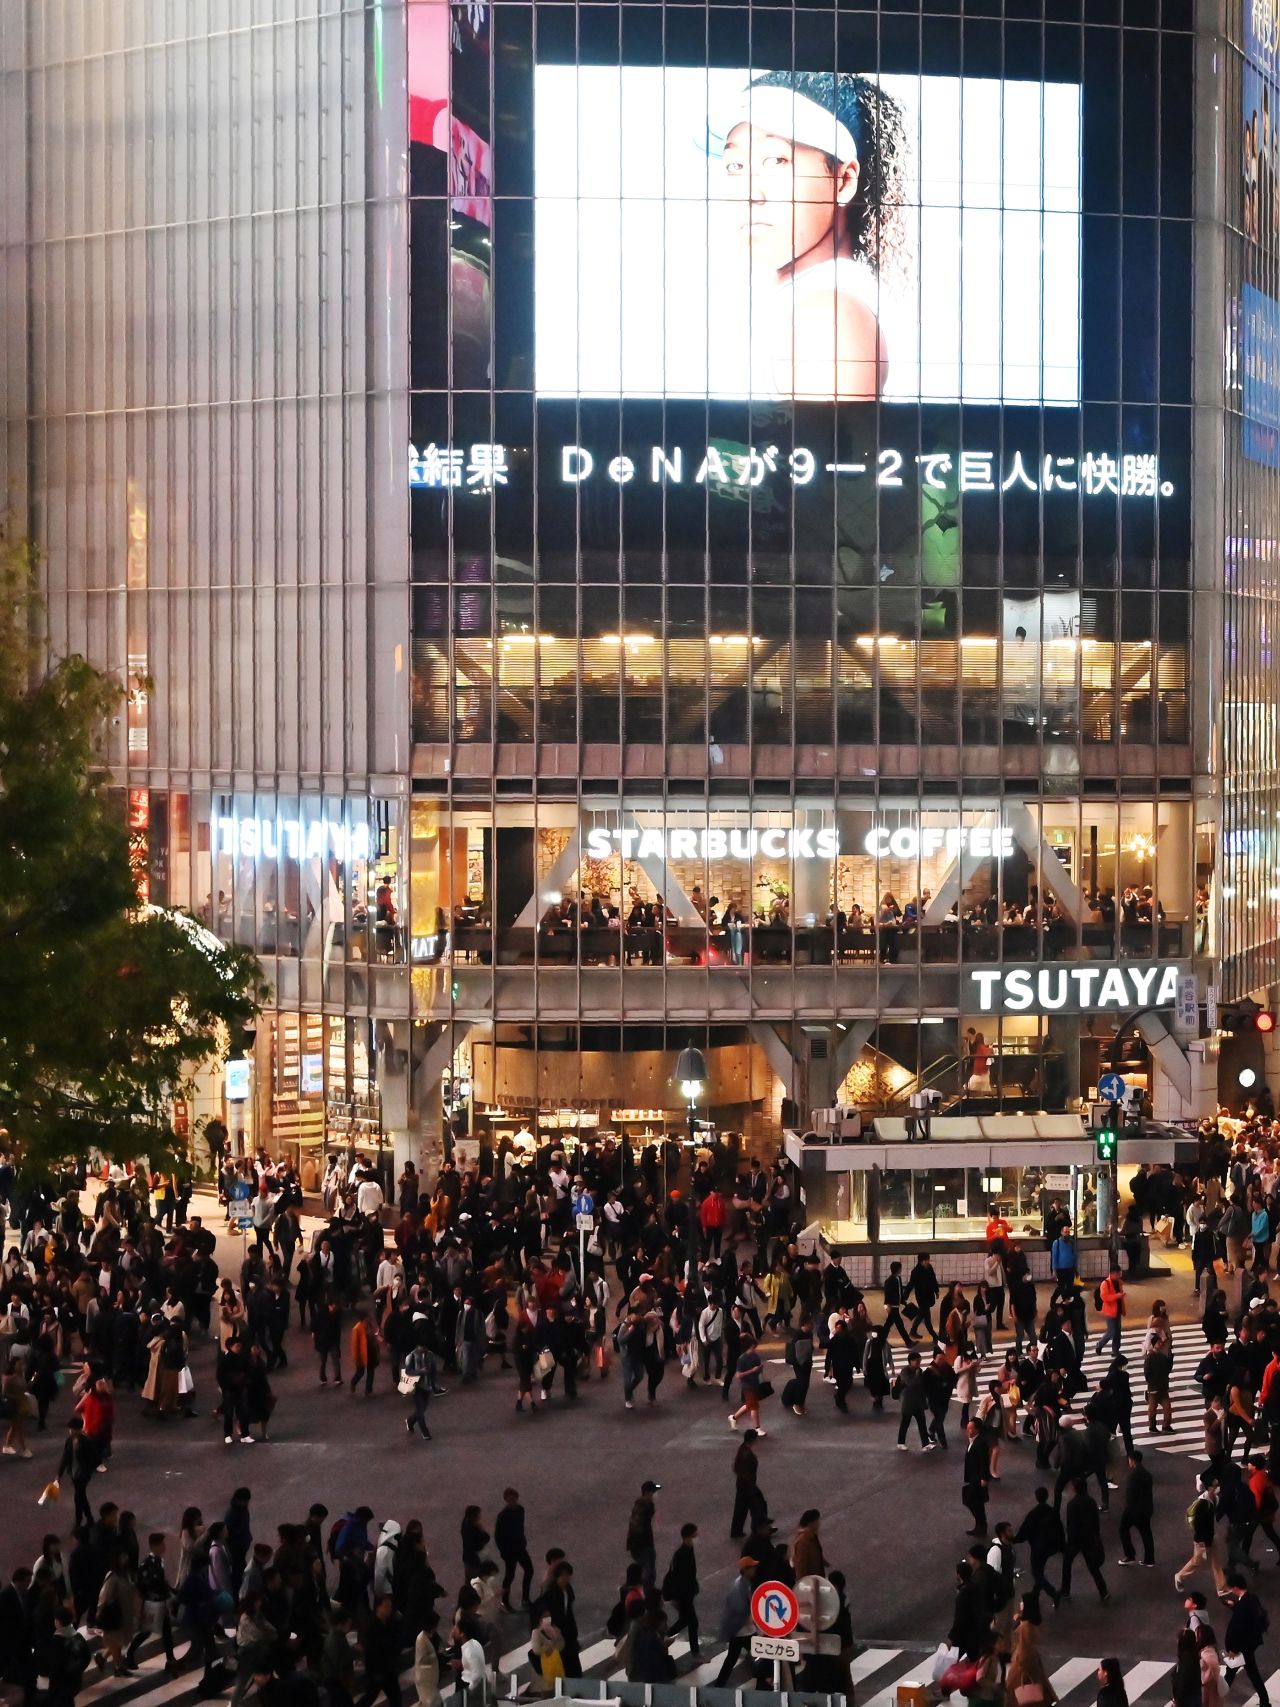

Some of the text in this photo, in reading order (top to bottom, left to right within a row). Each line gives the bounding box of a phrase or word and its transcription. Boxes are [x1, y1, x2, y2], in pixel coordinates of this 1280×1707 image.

[218, 818, 370, 860] TSUTAYA
[588, 827, 1015, 860] STARBUCKS COFFEE
[971, 967, 1178, 1010] TSUTAYA
[1184, 978, 1195, 1026] 渋谷駅前
[754, 1641, 797, 1658] ここから
